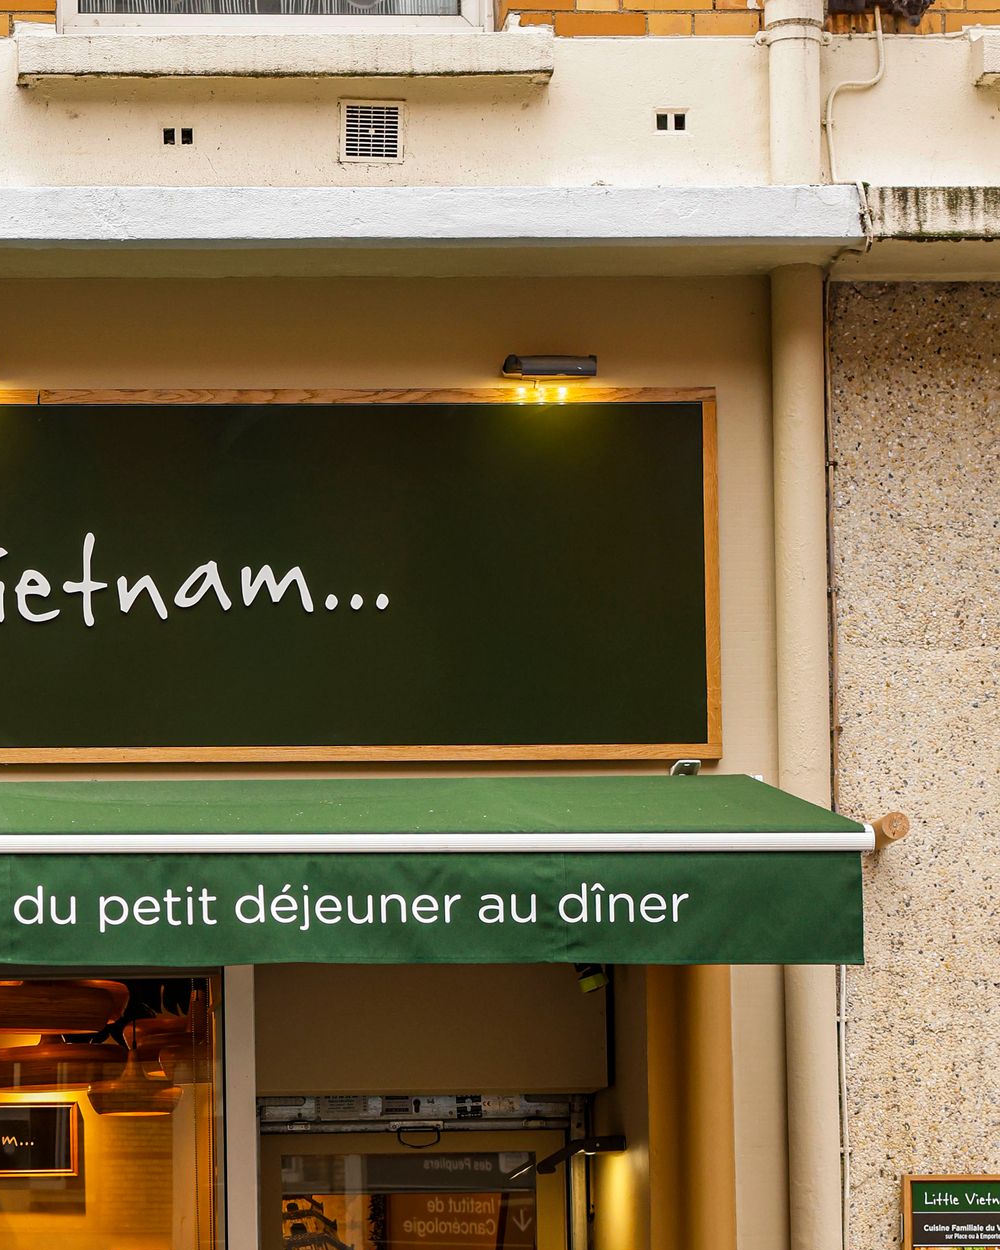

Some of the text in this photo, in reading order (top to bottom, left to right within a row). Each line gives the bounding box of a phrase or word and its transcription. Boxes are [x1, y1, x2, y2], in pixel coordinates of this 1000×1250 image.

[13, 885, 77, 925] du
[99, 885, 218, 933] petit
[235, 883, 462, 931] déjeuner
[478, 893, 536, 924] au
[558, 882, 690, 924] dîner
[924, 1191, 960, 1206] Little
[923, 1224, 950, 1232] Cuisine
[951, 1224, 984, 1232] Familiale
[985, 1224, 995, 1232] du
